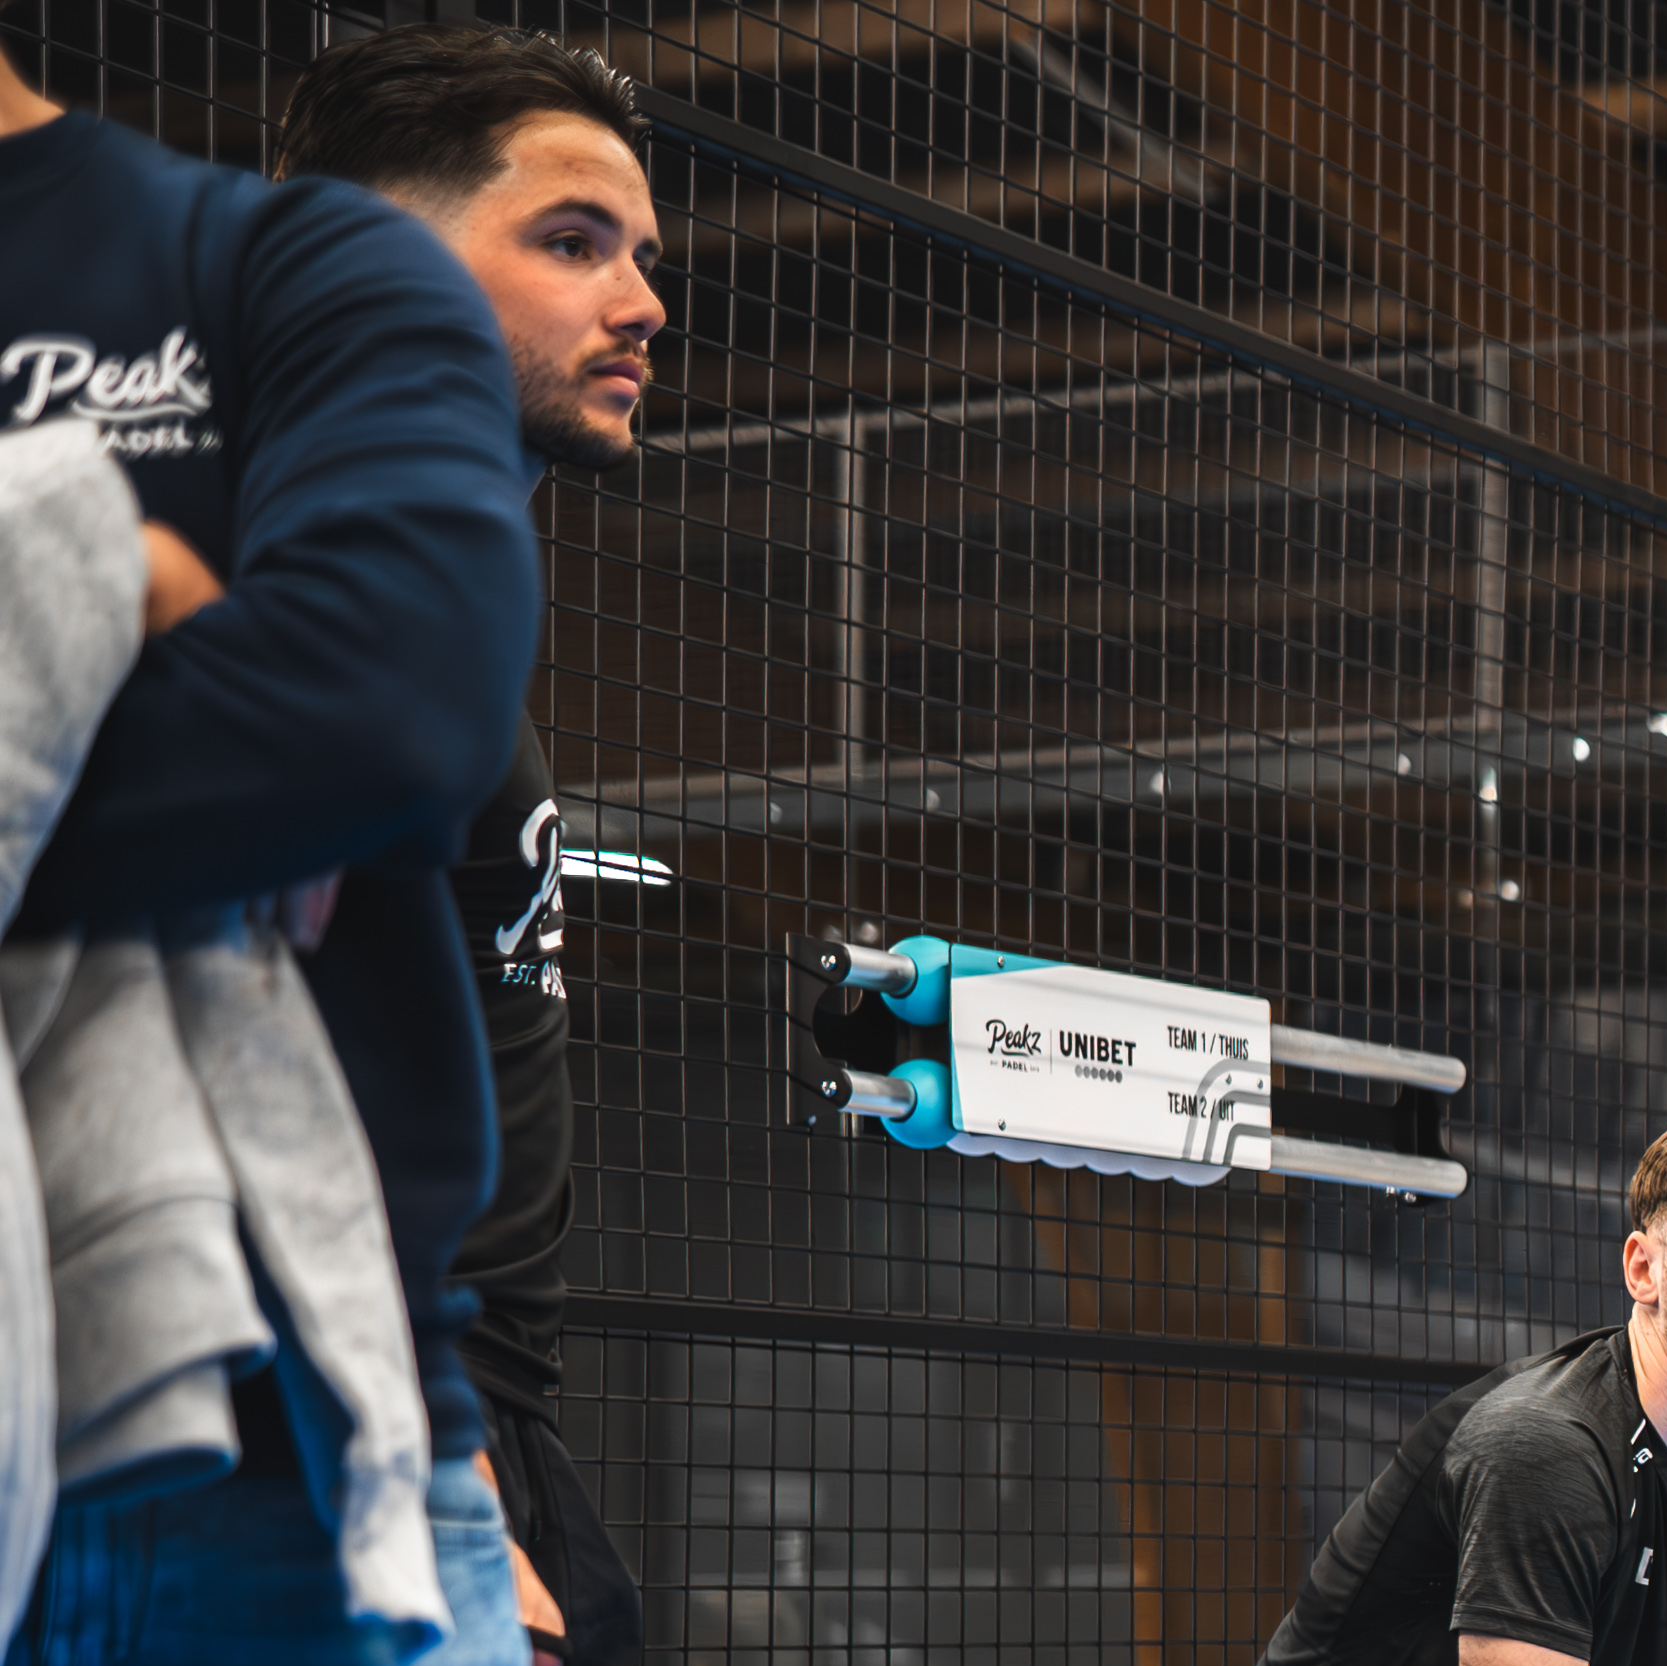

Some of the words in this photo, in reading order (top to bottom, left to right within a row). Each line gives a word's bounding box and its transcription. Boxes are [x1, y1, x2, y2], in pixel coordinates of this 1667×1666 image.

[986, 1019, 1041, 1057] Peakz
[1059, 1029, 1137, 1067] UNIBET
[1167, 1025, 1197, 1052] TEAM
[1201, 1032, 1207, 1053] 1
[1219, 1033, 1249, 1061] THUIS
[1002, 1059, 1028, 1073] PADEL
[1167, 1091, 1198, 1118] TEAM
[1200, 1095, 1207, 1119] 2
[1219, 1099, 1236, 1122] UIT
